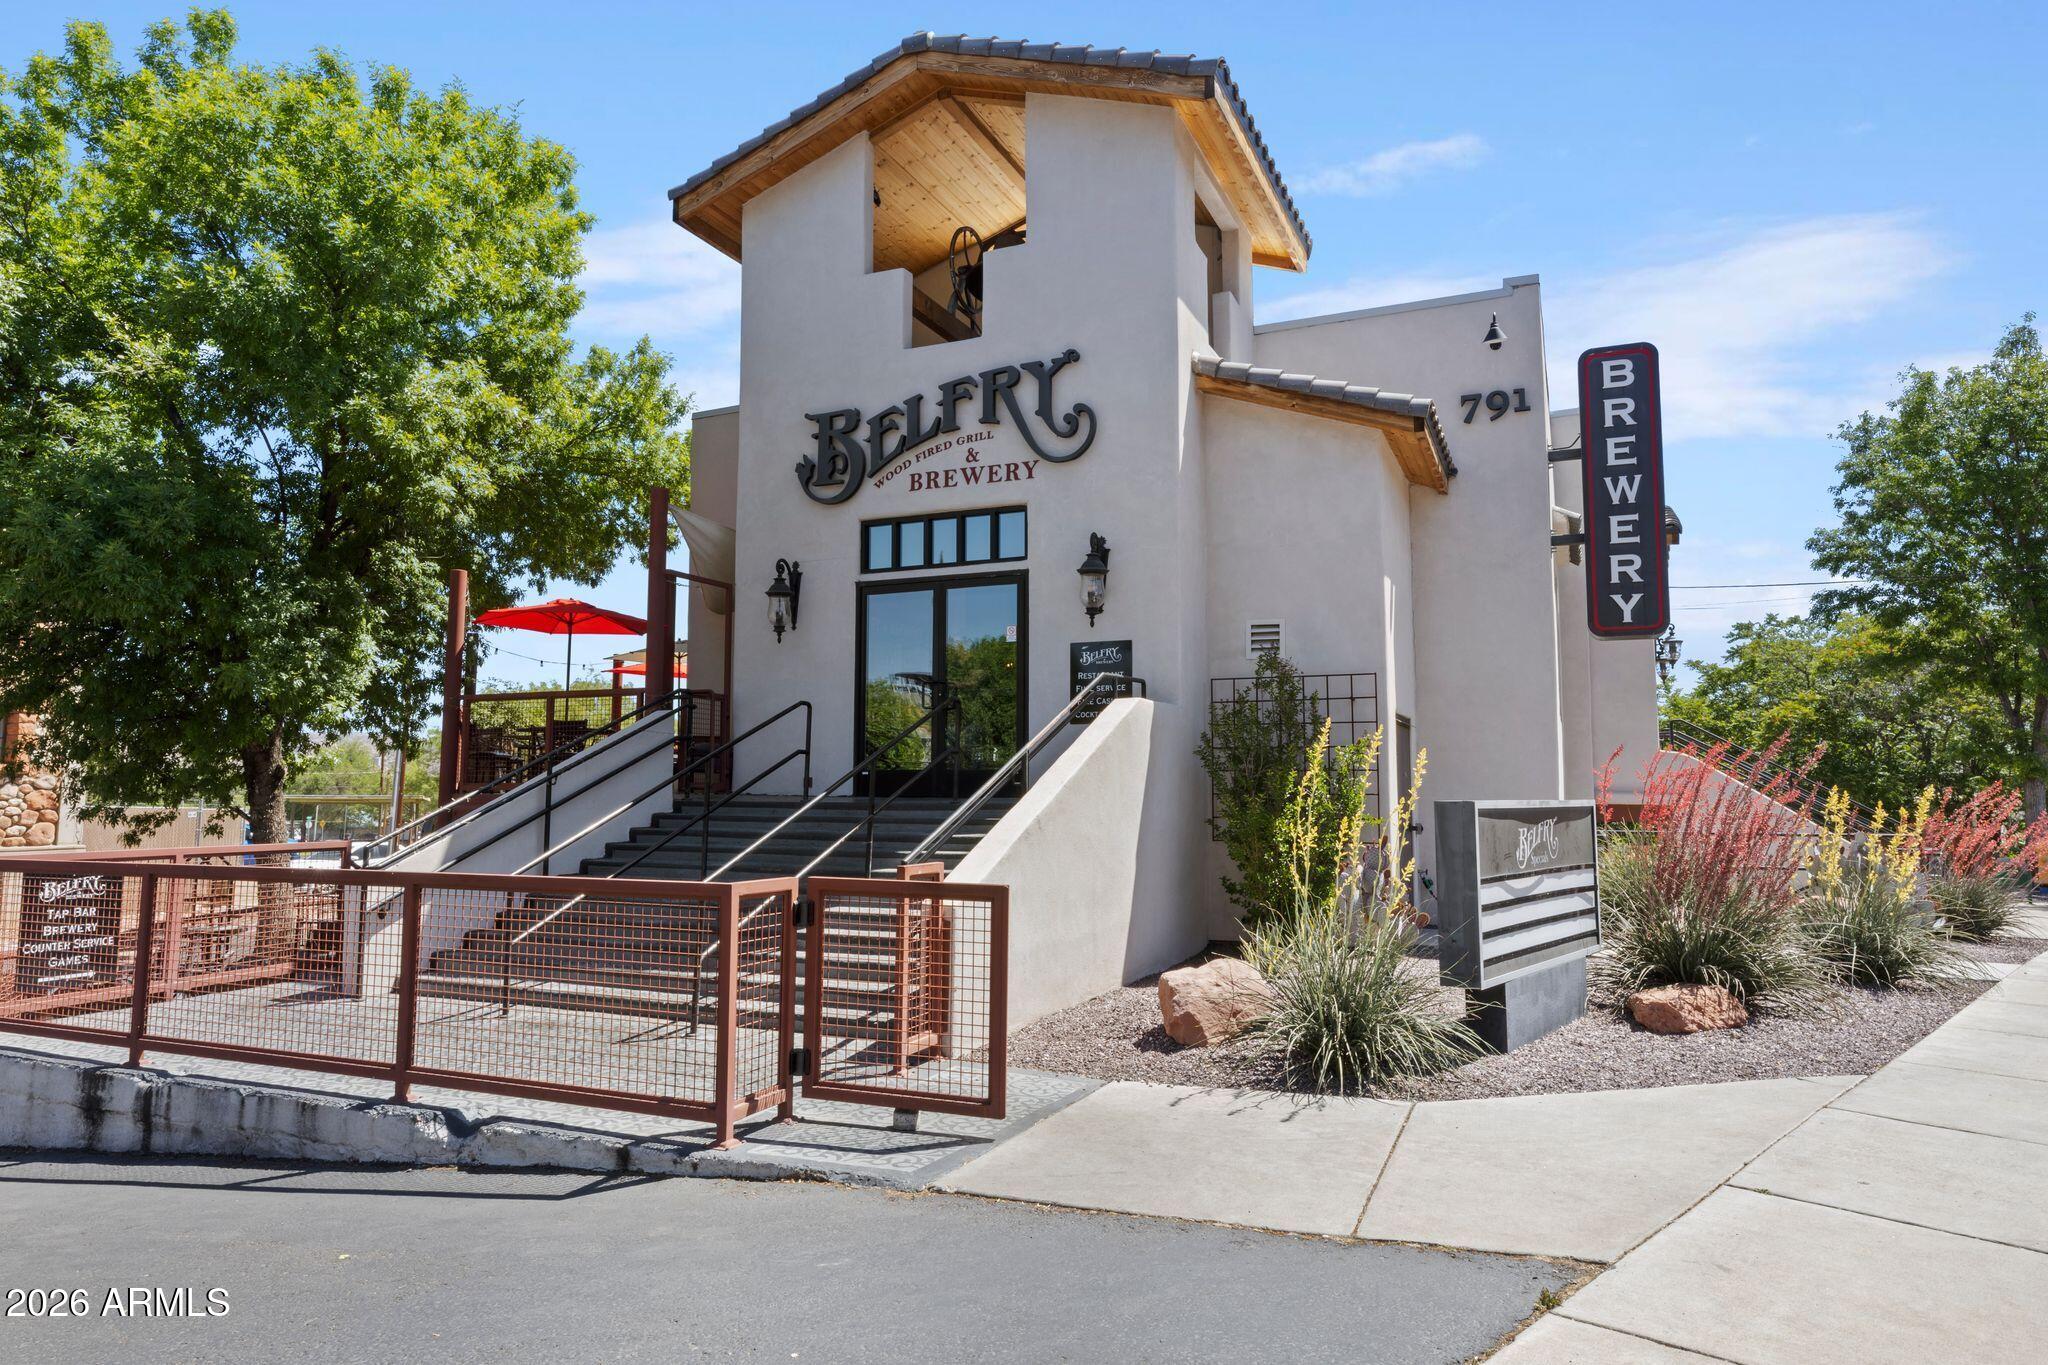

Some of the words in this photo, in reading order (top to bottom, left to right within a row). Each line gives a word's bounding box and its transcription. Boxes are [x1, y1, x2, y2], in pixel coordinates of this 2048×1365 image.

[1460, 387, 1531, 425] 791
[795, 348, 1097, 505] BELFRY
[873, 459, 912, 490] WOOD
[915, 440, 953, 464] FIRED
[956, 430, 994, 446] GRILL
[965, 447, 980, 463] &
[908, 459, 1040, 492] BREWERY
[1601, 358, 1644, 623] BREWERY
[1080, 646, 1122, 666] BELFRY
[1096, 684, 1126, 692] SERVCE
[1516, 816, 1559, 869] BELFRY
[39, 875, 106, 902] BELFRY
[47, 909, 70, 920] TAP
[74, 907, 97, 918] BAR
[43, 922, 98, 937] BREWERY
[22, 941, 71, 954] COUNTER
[74, 936, 114, 949] SERVICE
[48, 954, 89, 967] GAMES
